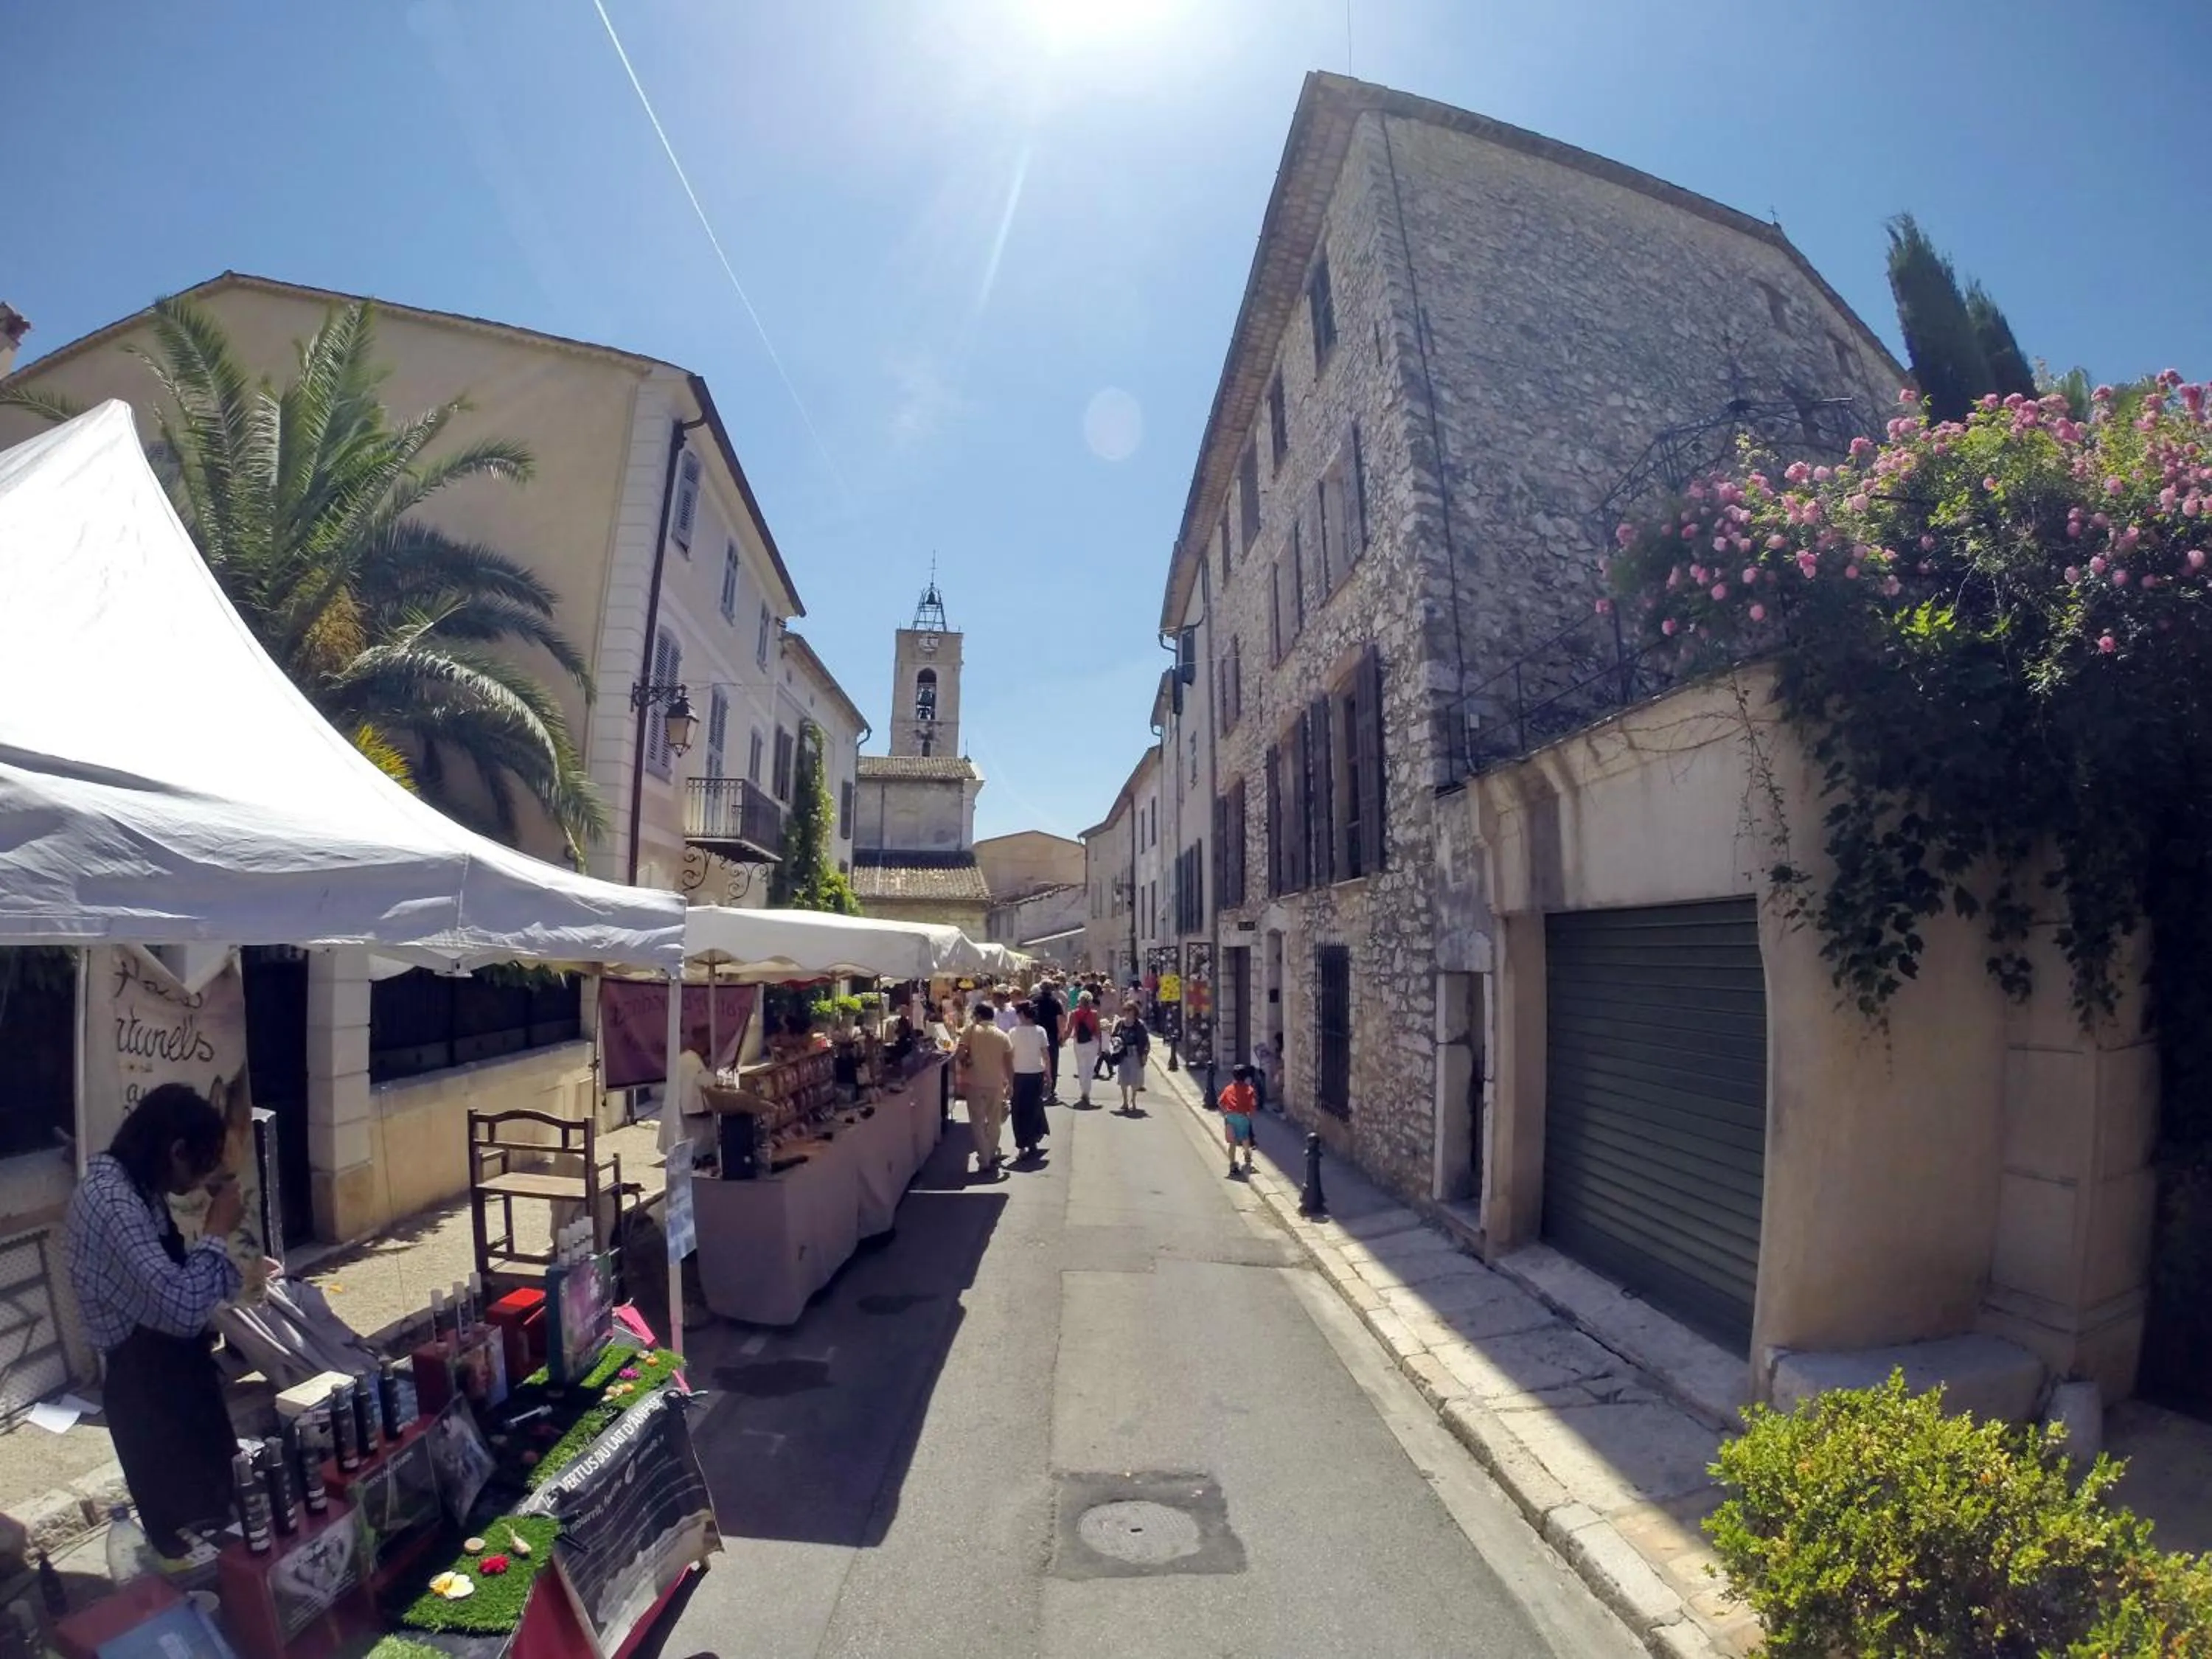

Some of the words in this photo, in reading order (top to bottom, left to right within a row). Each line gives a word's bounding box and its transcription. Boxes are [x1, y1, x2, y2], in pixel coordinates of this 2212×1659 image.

[558, 1455, 600, 1492] VERTUS
[594, 1445, 611, 1464] DU
[603, 1425, 628, 1451] LAIT
